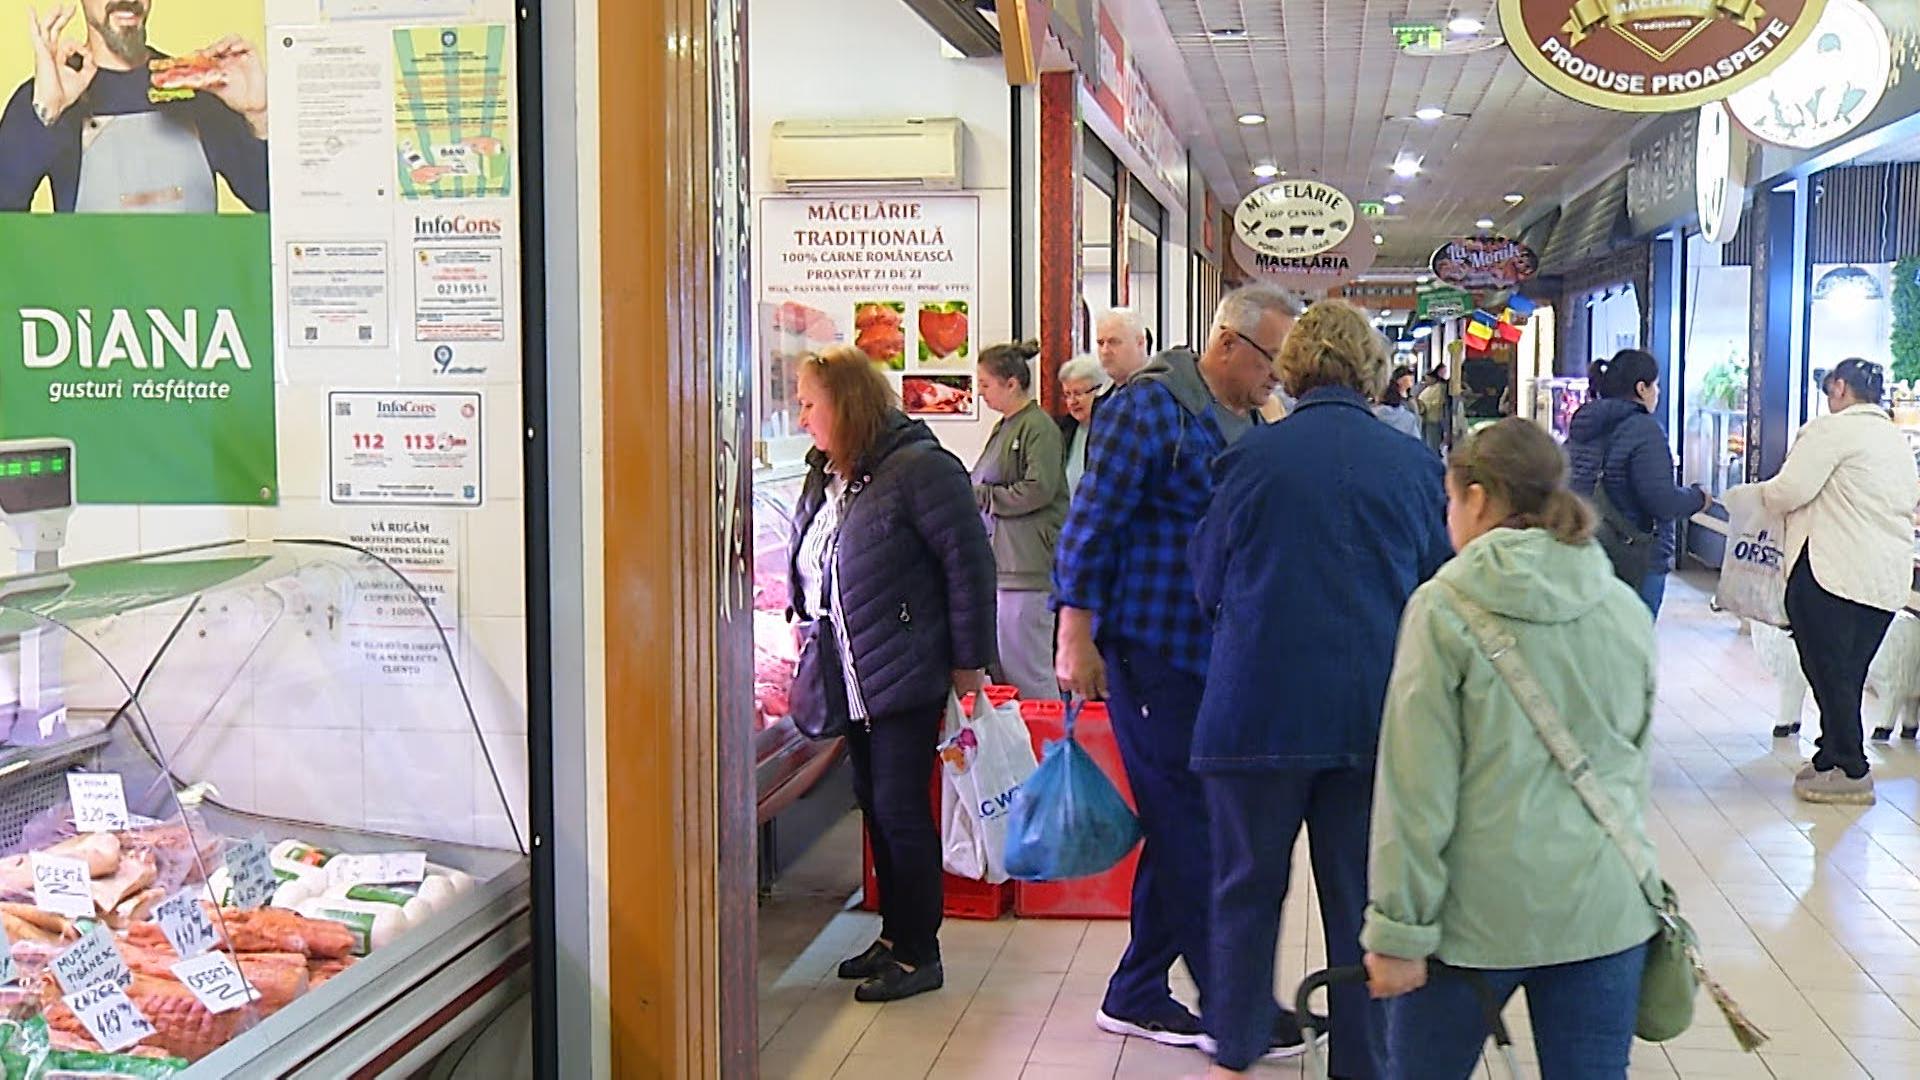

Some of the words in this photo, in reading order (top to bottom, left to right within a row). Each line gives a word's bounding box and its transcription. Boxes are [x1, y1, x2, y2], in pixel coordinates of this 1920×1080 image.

[1540, 36, 1645, 94] PRODUSE
[1652, 17, 1791, 94] PROASPETE
[808, 201, 921, 220] MĂCELĂRIE
[415, 214, 501, 233] InfoCons
[781, 252, 817, 263] 100%
[820, 251, 863, 263] CARNE
[874, 269, 886, 279] ZI
[889, 269, 905, 279] DE
[909, 269, 922, 279] ZI
[18, 308, 252, 369] DIANA
[49, 379, 122, 402] gusturi
[377, 400, 436, 413] InfoCons
[353, 433, 384, 449] 112
[404, 434, 435, 449] 113
